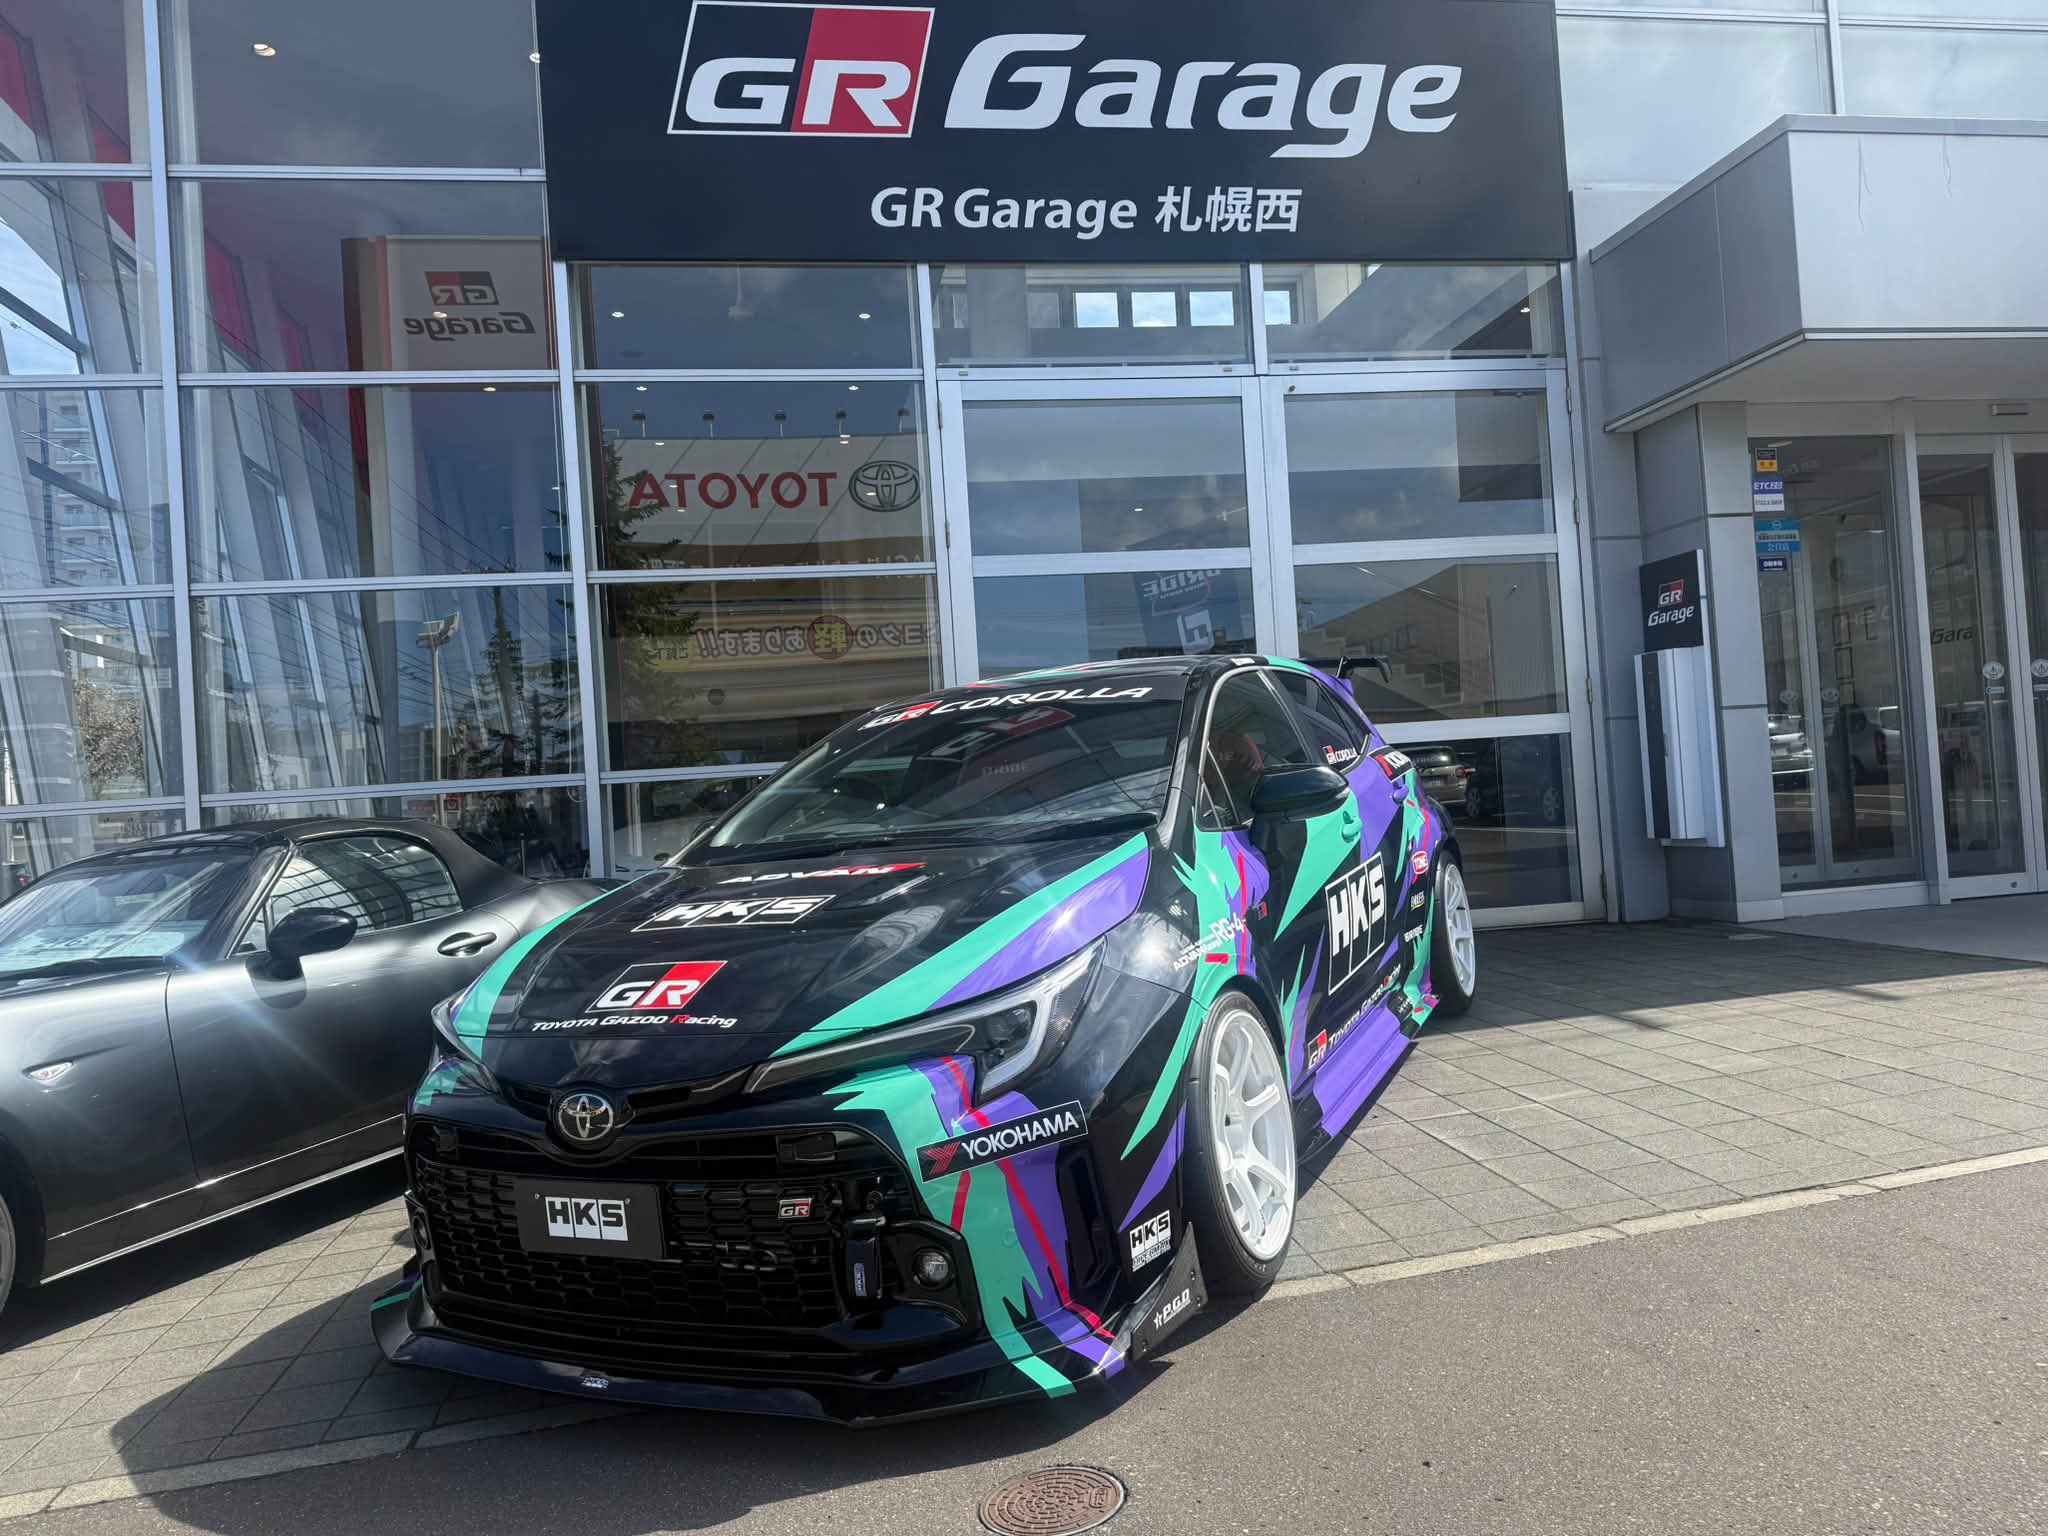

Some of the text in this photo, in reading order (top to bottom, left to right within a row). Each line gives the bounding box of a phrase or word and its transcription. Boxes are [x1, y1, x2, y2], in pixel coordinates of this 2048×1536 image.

[686, 34, 1462, 158] GR Garage
[870, 186, 1302, 240] GR Garage 札幌西
[1659, 589, 1682, 605] GR
[1648, 605, 1695, 627] Garage
[930, 687, 1153, 715] COROLLA
[656, 898, 817, 923] HKS
[1328, 864, 1385, 957] HKS
[597, 979, 700, 1009] GR
[531, 1013, 738, 1031] TOYOTA GAZOO Racing
[961, 1111, 1080, 1160] YOKOHAMA
[549, 1202, 625, 1228] HKS
[780, 1204, 810, 1217] GR
[1131, 1211, 1169, 1249] HKS
